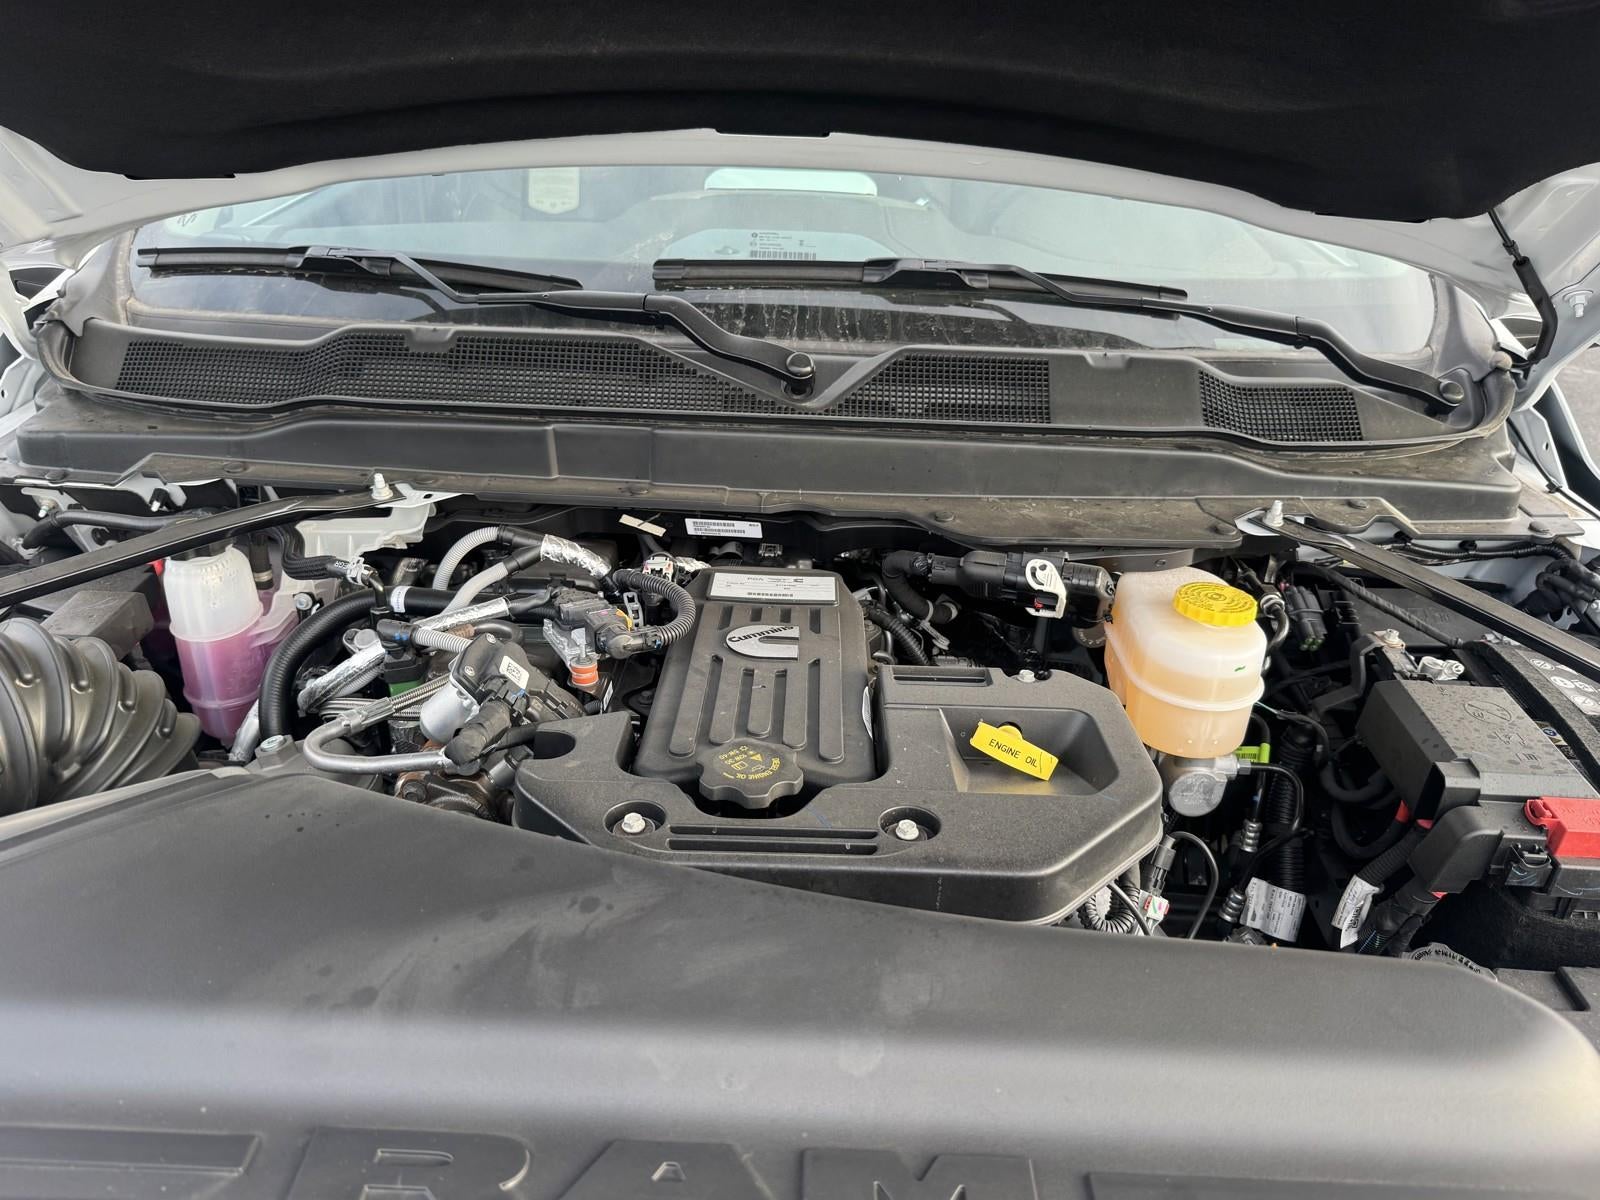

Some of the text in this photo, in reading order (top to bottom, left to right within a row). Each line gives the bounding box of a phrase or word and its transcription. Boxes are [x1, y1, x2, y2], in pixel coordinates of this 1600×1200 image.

[728, 626, 794, 643] Cummins
[988, 738, 1038, 768] ENGINE OIL
